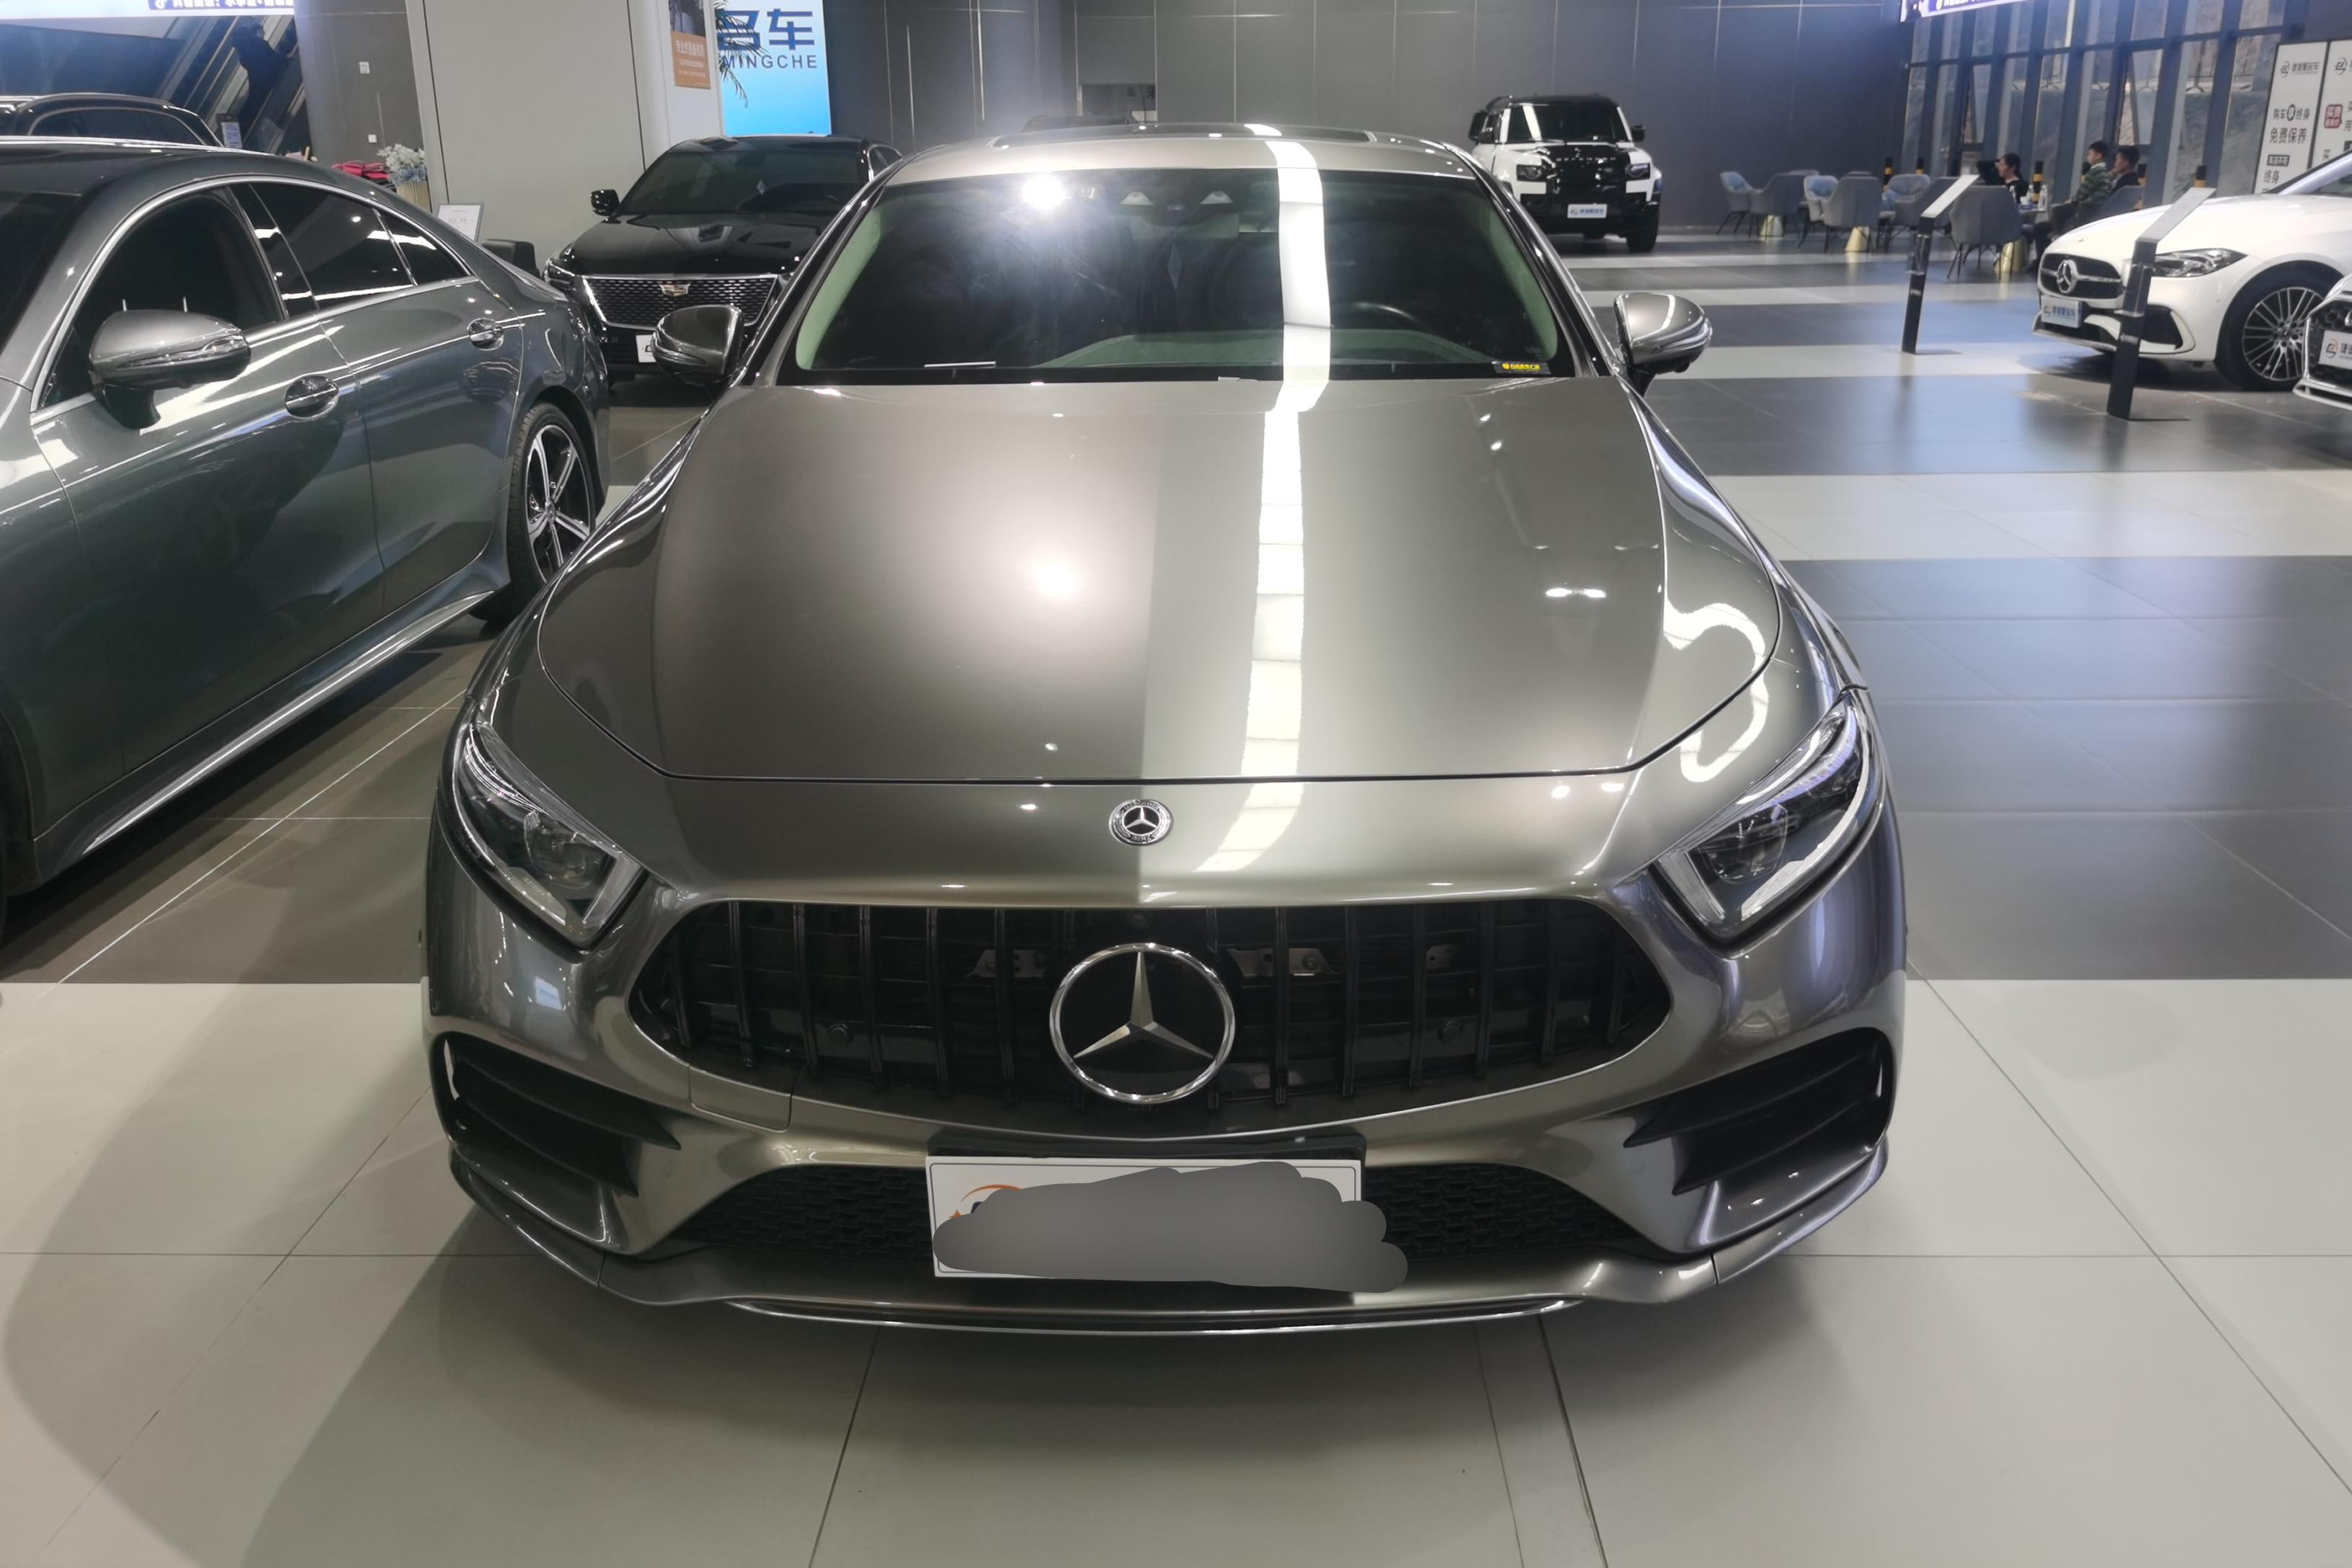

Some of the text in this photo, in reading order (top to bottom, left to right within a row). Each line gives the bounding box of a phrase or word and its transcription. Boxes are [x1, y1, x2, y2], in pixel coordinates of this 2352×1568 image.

[717, 9, 815, 50] 名车
[722, 55, 818, 68] MINGCHE
[2269, 127, 2307, 144] 免费保养
[2263, 169, 2280, 184] 终身
